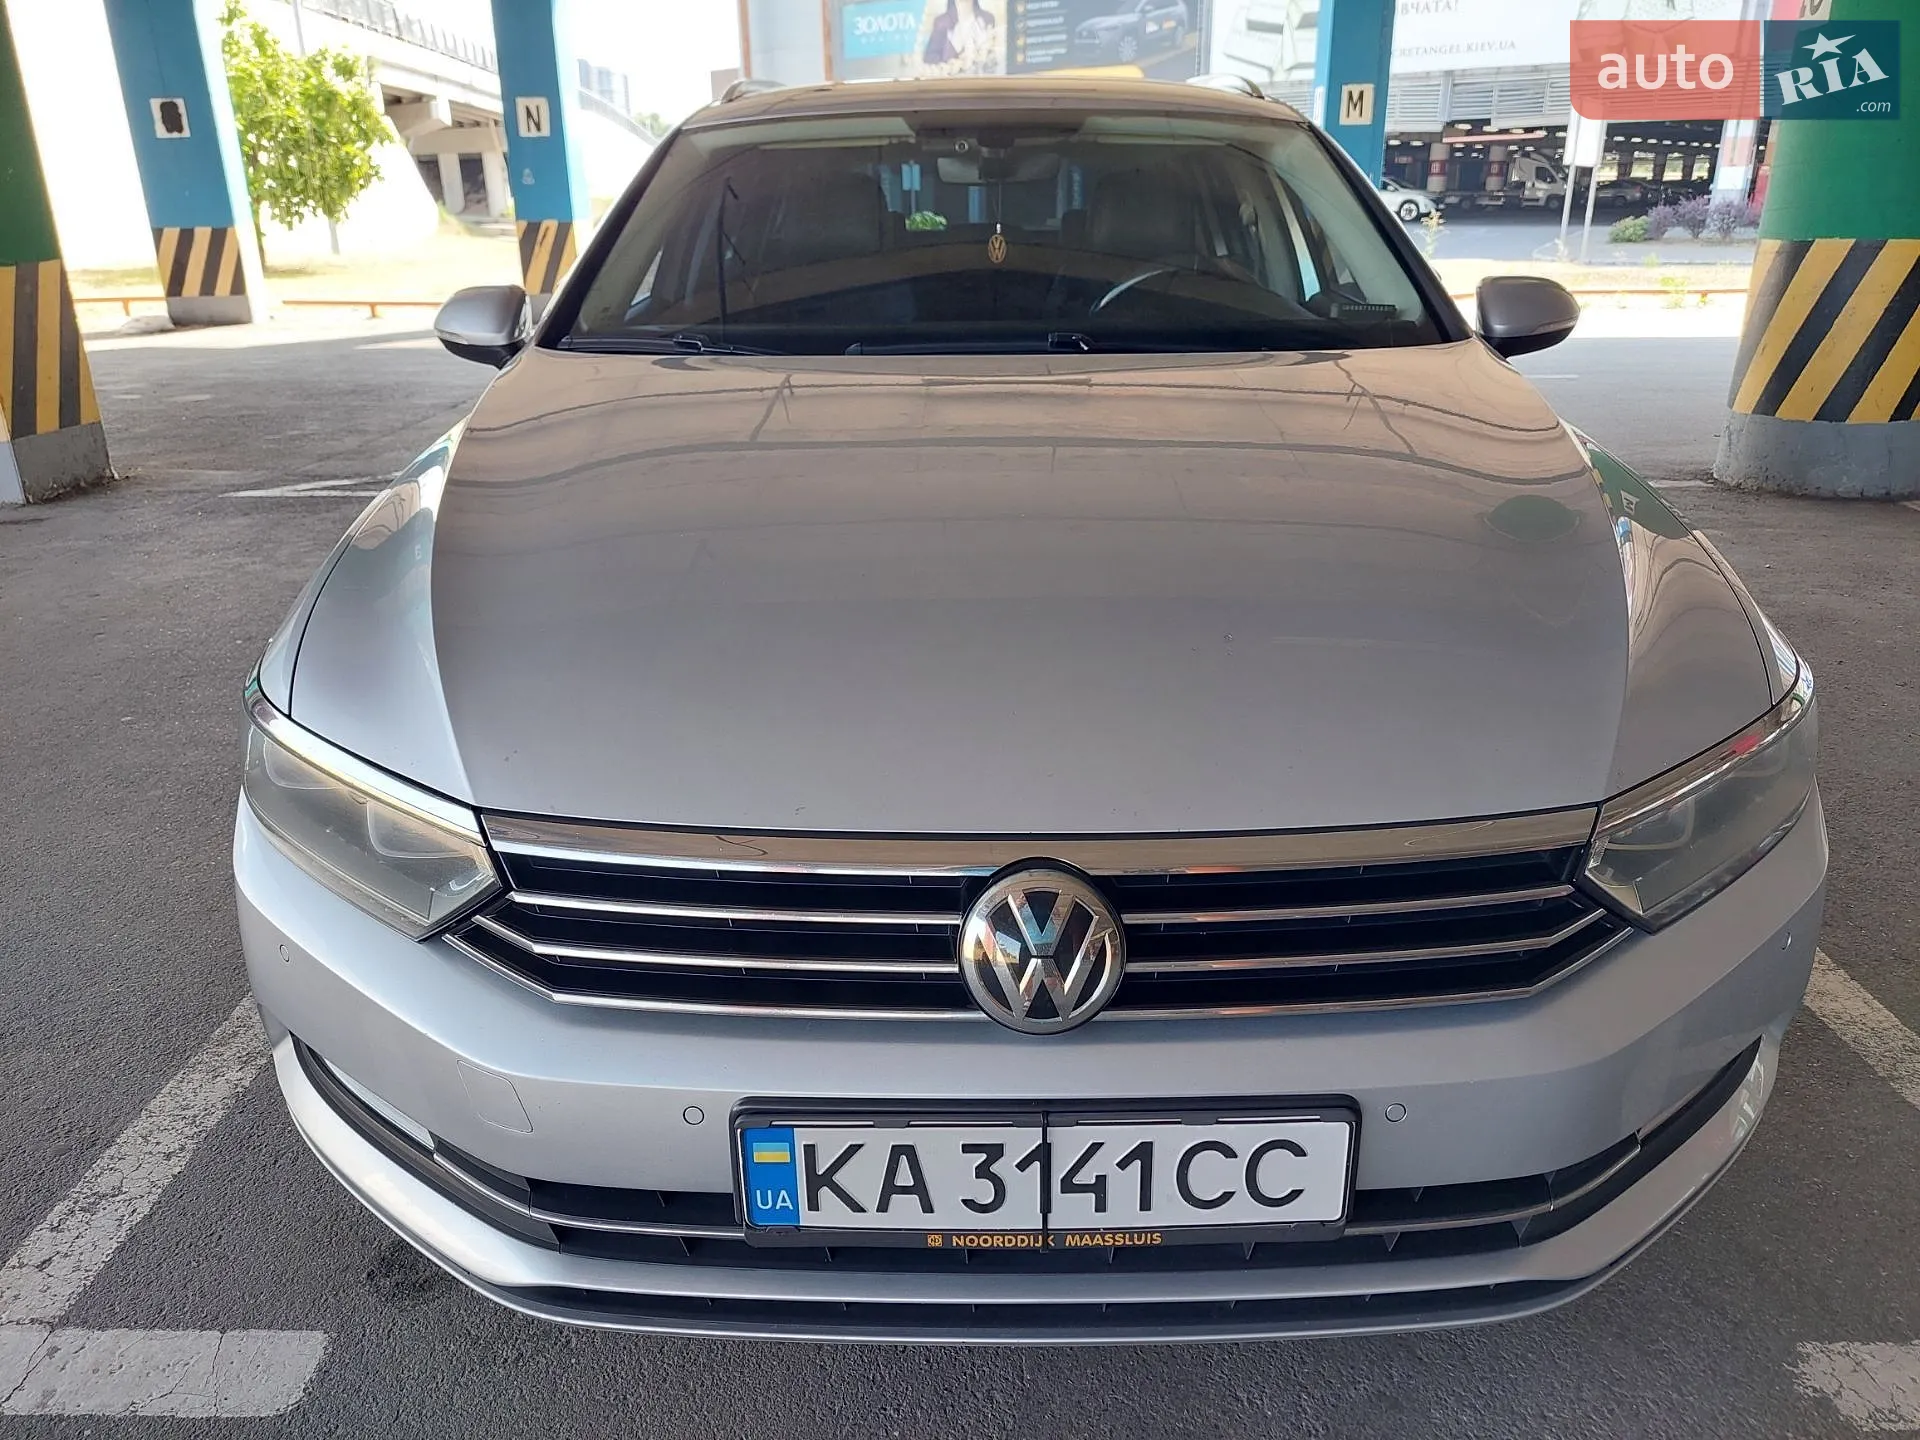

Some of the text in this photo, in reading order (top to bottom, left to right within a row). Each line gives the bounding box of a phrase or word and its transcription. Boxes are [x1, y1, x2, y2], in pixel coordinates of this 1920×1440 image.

[525, 104, 542, 133] N
[1346, 89, 1364, 119] M
[803, 1138, 1308, 1214] KA 3141 CC
[756, 1189, 794, 1211] UA
[1065, 1233, 1162, 1247] MAASSLUIS
